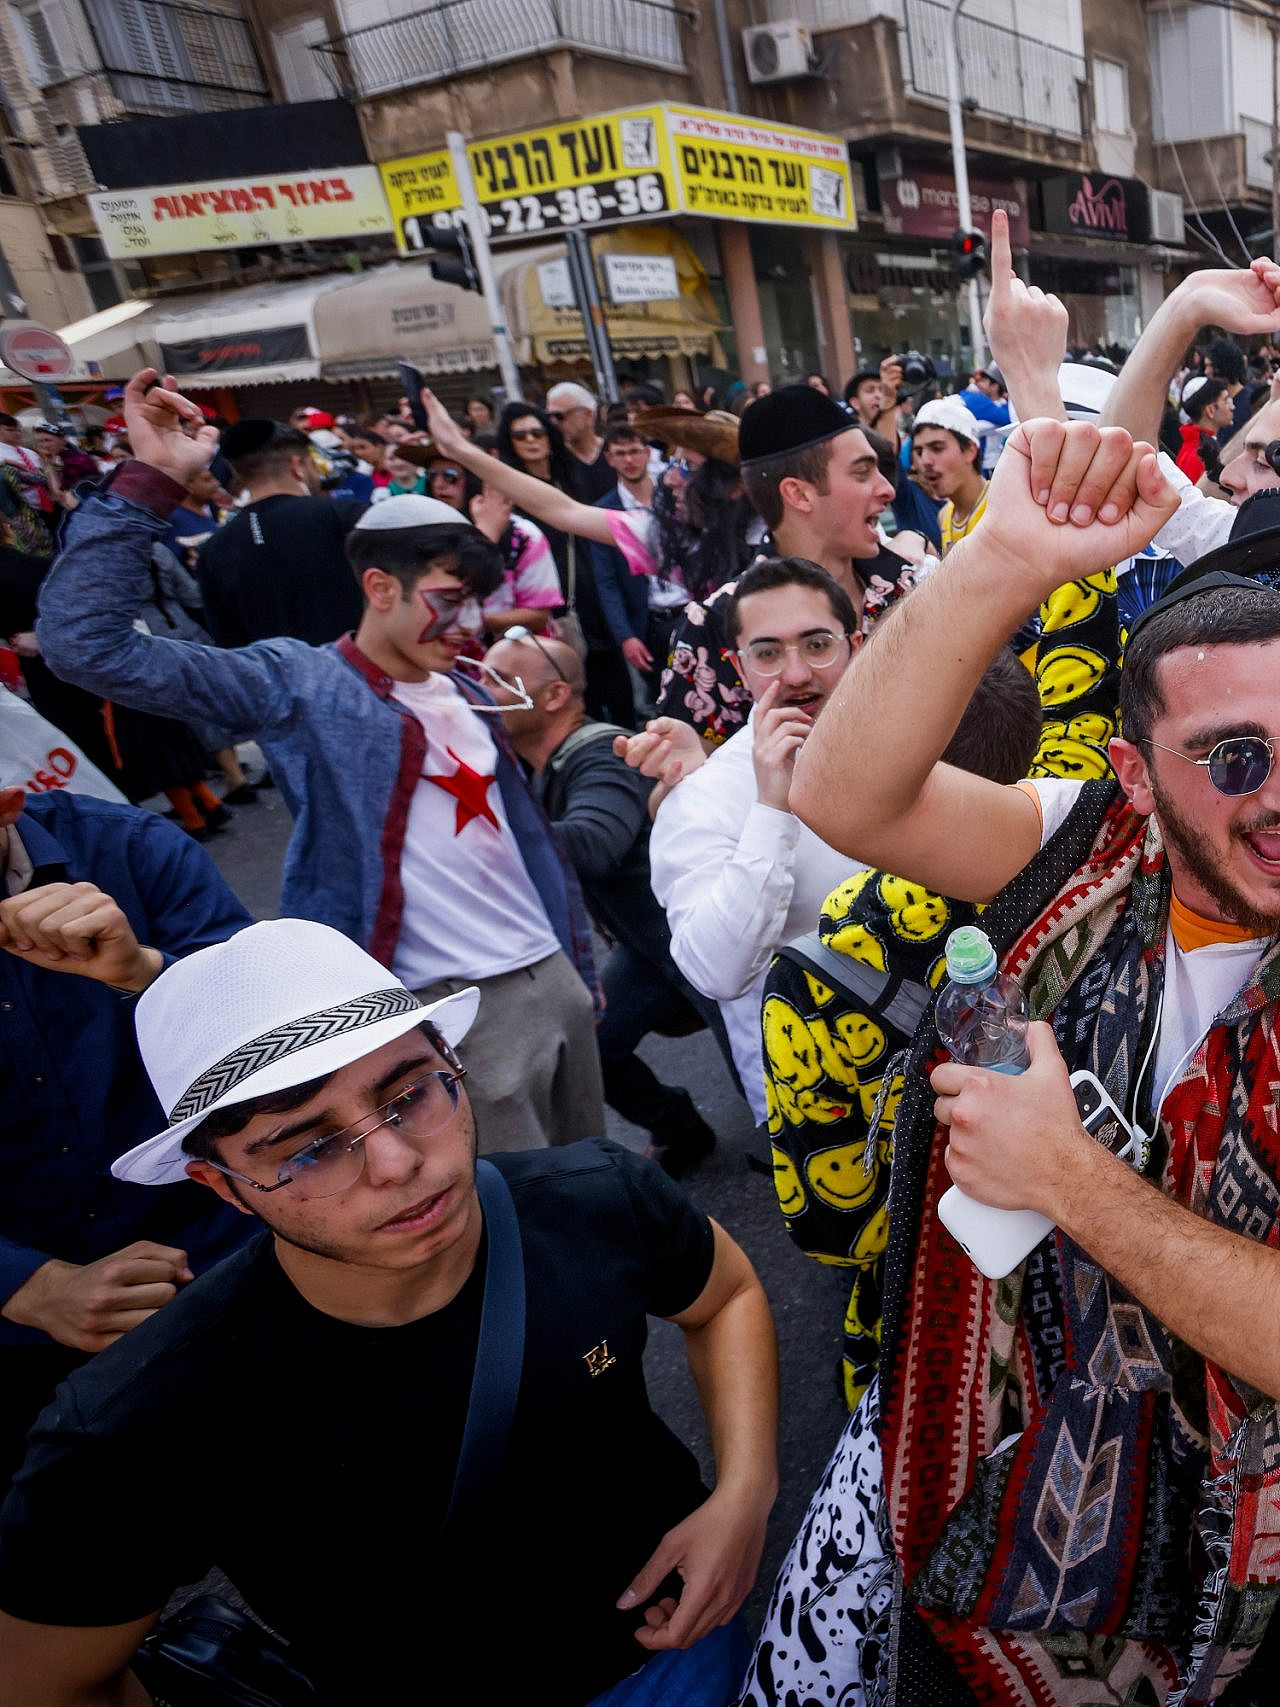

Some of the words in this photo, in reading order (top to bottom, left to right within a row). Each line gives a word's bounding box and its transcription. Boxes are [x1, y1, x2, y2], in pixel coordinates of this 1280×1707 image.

[474, 137, 556, 193] הרבני
[559, 123, 618, 178] ועד
[681, 145, 764, 185] הרבנים
[278, 178, 355, 207] באזר
[768, 157, 806, 190] ועד
[152, 184, 278, 222] המציאות
